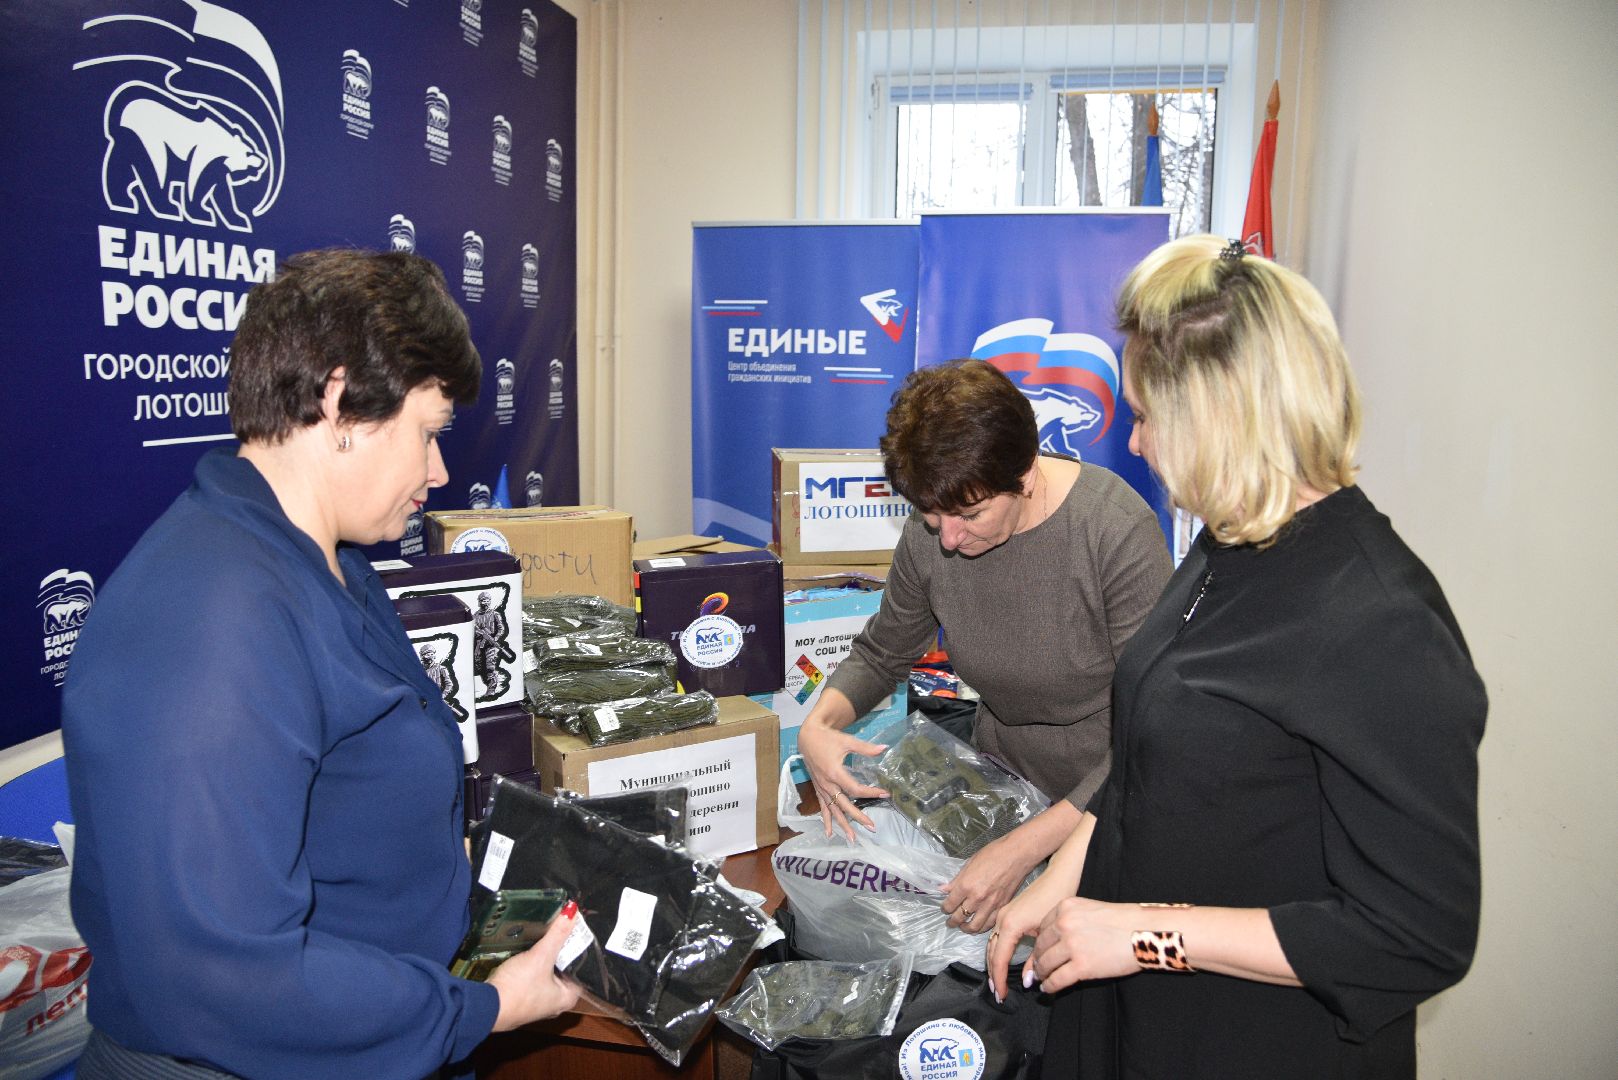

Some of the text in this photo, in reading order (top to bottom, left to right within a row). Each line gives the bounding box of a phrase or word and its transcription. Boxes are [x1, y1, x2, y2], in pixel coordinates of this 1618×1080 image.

[98, 225, 276, 283] ЕДИНАЯ
[728, 328, 867, 358] ЕДИНЫЕ
[727, 361, 797, 372] Центр объединения
[727, 374, 812, 384] гражданских инициатив
[805, 476, 902, 500] МГЕ
[44, 629, 82, 648] ЕДИН
[795, 633, 861, 648] МОУ «Лотоши
[696, 642, 723, 651] ЕДИНАЯ
[815, 645, 850, 656] СОШ №
[697, 648, 723, 657] РОССИЯ
[921, 1061, 957, 1072] ЕДИНАЯ
[922, 1071, 958, 1080] РОССИЯ
